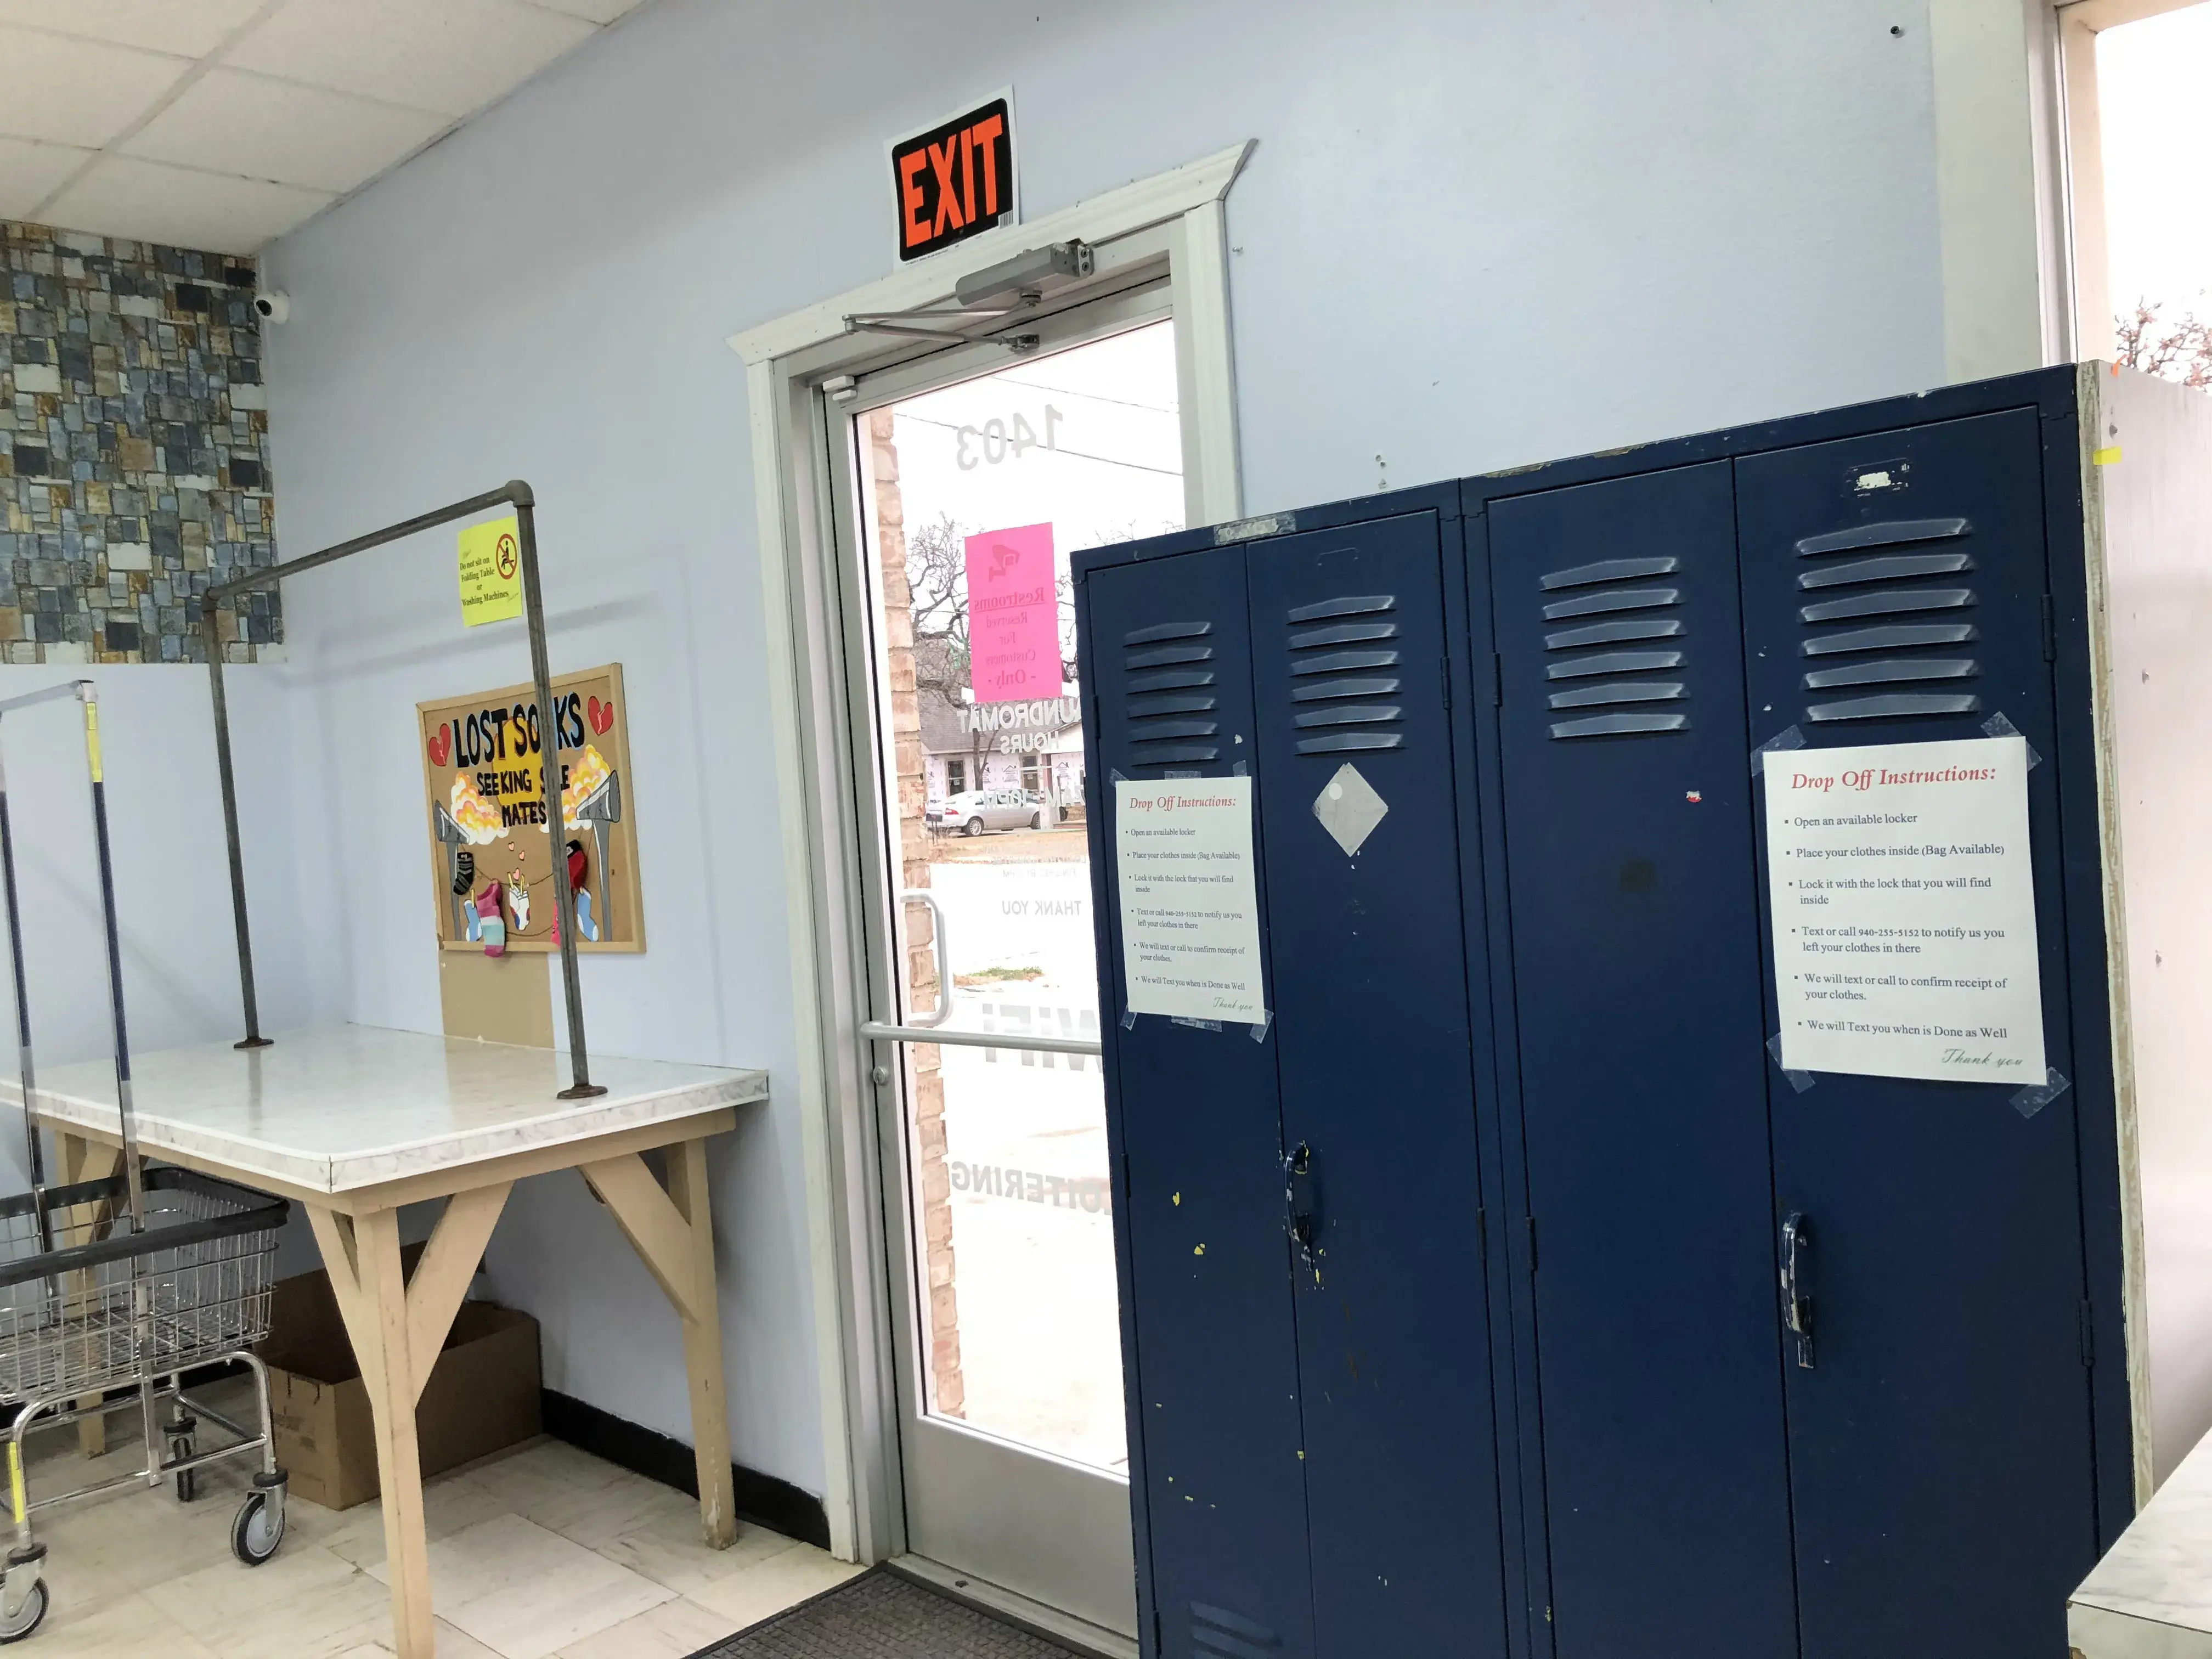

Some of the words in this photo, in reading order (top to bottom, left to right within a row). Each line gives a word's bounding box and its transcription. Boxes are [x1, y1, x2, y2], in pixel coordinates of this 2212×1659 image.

[900, 113, 1003, 248] EXIT
[460, 562, 466, 571] Do
[467, 560, 475, 568] not
[461, 572, 479, 583] Folding
[480, 568, 495, 577] Table
[462, 595, 483, 607] Washing
[484, 590, 509, 602] Machines
[452, 708, 508, 768] LOST
[512, 691, 585, 758] SOKS
[477, 769, 532, 796] SEEKING
[1791, 774, 1834, 793] Drop
[1842, 769, 1876, 791] Off
[1878, 765, 1996, 785] Instructions:
[1130, 798, 1153, 811] Drop
[1157, 795, 1175, 811] Off
[1177, 795, 1236, 808] Instructions:
[501, 801, 548, 828] MATES
[1794, 816, 1820, 828] Open
[1822, 818, 1834, 826] an
[1837, 815, 1883, 825] available
[1884, 813, 1918, 823] locker
[1131, 829, 1145, 837] Open
[1147, 853, 1159, 861] your
[1197, 851, 1210, 860] (Bag
[1211, 851, 1240, 860] Available)
[1796, 848, 1823, 858] Place
[1825, 850, 1848, 859] your
[1850, 847, 1886, 856] clothes
[1888, 845, 1920, 856] inside
[1921, 845, 1946, 857] (Bag
[1949, 844, 2005, 855] Available)
[1799, 879, 1825, 889] Lock
[1826, 879, 1833, 889] it
[1835, 879, 1858, 889] with
[1860, 879, 1875, 888] the
[1877, 878, 1899, 888] lock
[1901, 878, 1921, 888] that
[1923, 880, 1943, 890] you
[1946, 878, 1966, 887] will
[1969, 877, 1992, 887] find
[1800, 895, 1829, 905] inside
[1204, 911, 1222, 920] notify
[1802, 926, 1824, 936] Text
[1826, 928, 1836, 936] or
[1838, 927, 1857, 936] call
[1858, 928, 1919, 938] 940-255-5152
[1922, 929, 1932, 938] to
[1934, 927, 1966, 940] notify
[1983, 930, 2005, 940] you
[1217, 947, 1238, 955] receipt
[1803, 942, 1820, 952] left
[1821, 944, 1843, 954] your
[1845, 943, 1880, 953] clothes
[1883, 944, 1893, 953] in
[1895, 944, 1921, 953] there
[1153, 954, 1172, 962] clothes.
[1163, 977, 1175, 985] Text
[1231, 982, 1245, 990] Well
[1804, 973, 1821, 984] We
[1823, 974, 1842, 984] will
[1844, 975, 1863, 984] text
[1865, 977, 1876, 985] or
[1877, 975, 1896, 986] call
[1898, 977, 1909, 986] to
[1911, 977, 1953, 987] confirm
[1954, 978, 1993, 990] receipt
[1995, 978, 2008, 989] of
[1805, 991, 1827, 1001] your
[1829, 990, 1867, 1000] clothes.
[1212, 997, 1238, 1009] Thank
[1807, 1019, 1825, 1030] We
[1826, 1021, 1845, 1031] will
[1847, 1022, 1870, 1032] Text
[1872, 1025, 1891, 1035] you
[1893, 1024, 1921, 1035] when
[1922, 1025, 1932, 1035] is
[1933, 1025, 1963, 1037] Done
[1965, 1029, 1977, 1037] as
[1979, 1028, 2008, 1039] Well
[1942, 1048, 1993, 1065] Thank
[1997, 1057, 2023, 1068] you
